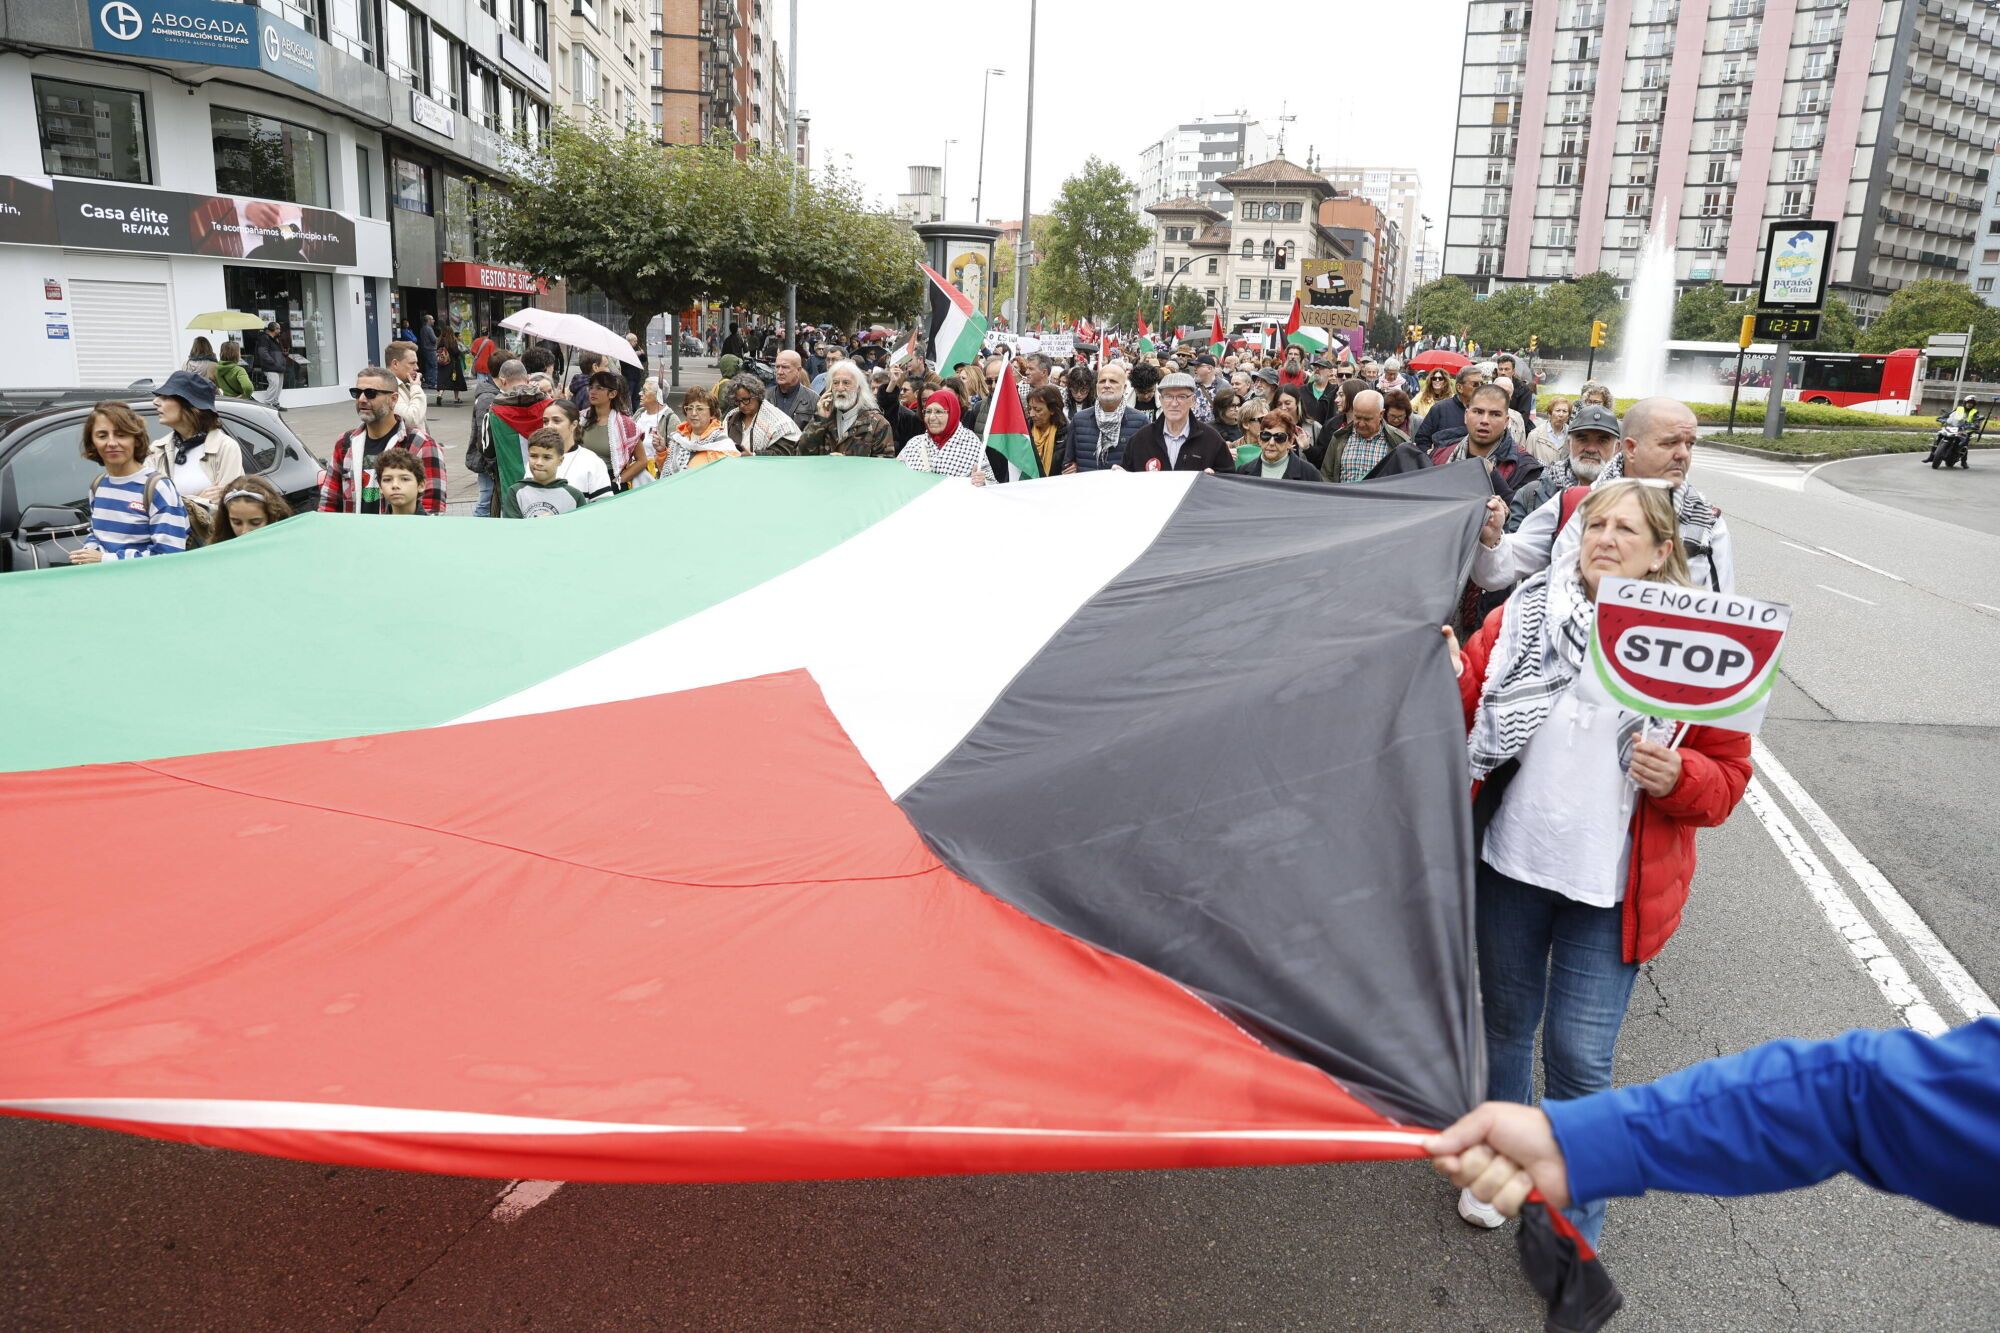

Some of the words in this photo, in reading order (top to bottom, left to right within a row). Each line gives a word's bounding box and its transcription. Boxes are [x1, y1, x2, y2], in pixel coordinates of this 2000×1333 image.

[151, 12, 248, 36] ABOGADA
[151, 27, 213, 41] ADMINISTRACIÓN
[213, 33, 223, 41] DE
[224, 36, 249, 45] FINCAS
[281, 36, 315, 63] ABOGADA
[80, 203, 125, 221] Casa
[130, 207, 169, 224] élite
[122, 222, 170, 236] RE/MAX
[211, 221, 221, 231] Te
[223, 223, 279, 237] acompañamos
[291, 230, 321, 241] principio
[322, 233, 327, 241] a
[327, 234, 340, 243] fin,
[481, 269, 506, 287] RESTOS
[508, 273, 516, 288] DE
[1300, 309, 1358, 328] VERGÜENZA
[1768, 319, 1810, 332] 12:37
[1618, 583, 1778, 623] GENOCIDIO
[1623, 634, 1746, 677] STOP
